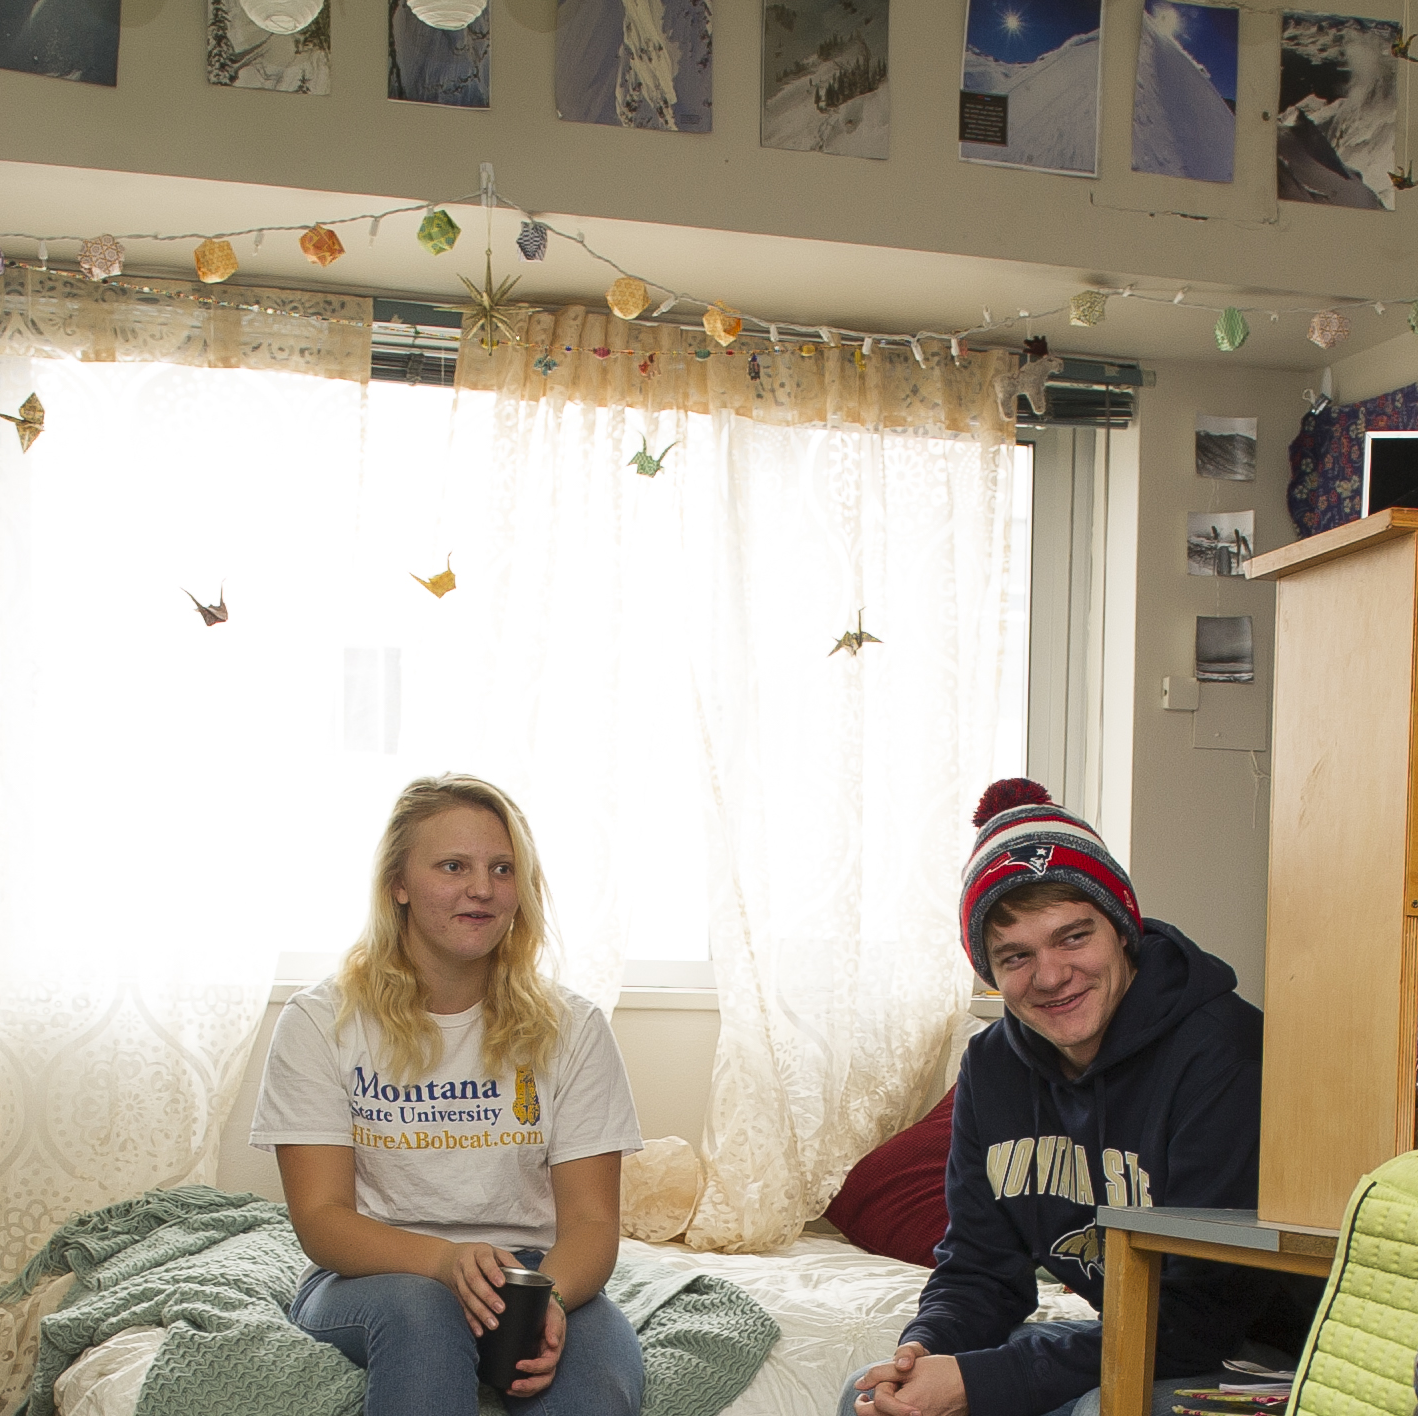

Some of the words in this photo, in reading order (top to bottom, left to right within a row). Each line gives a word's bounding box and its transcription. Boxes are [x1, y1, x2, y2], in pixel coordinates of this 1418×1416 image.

[354, 1066, 501, 1103] Montana
[351, 1101, 393, 1122] State
[398, 1104, 503, 1126] University
[353, 1124, 545, 1150] HireABobcat.com
